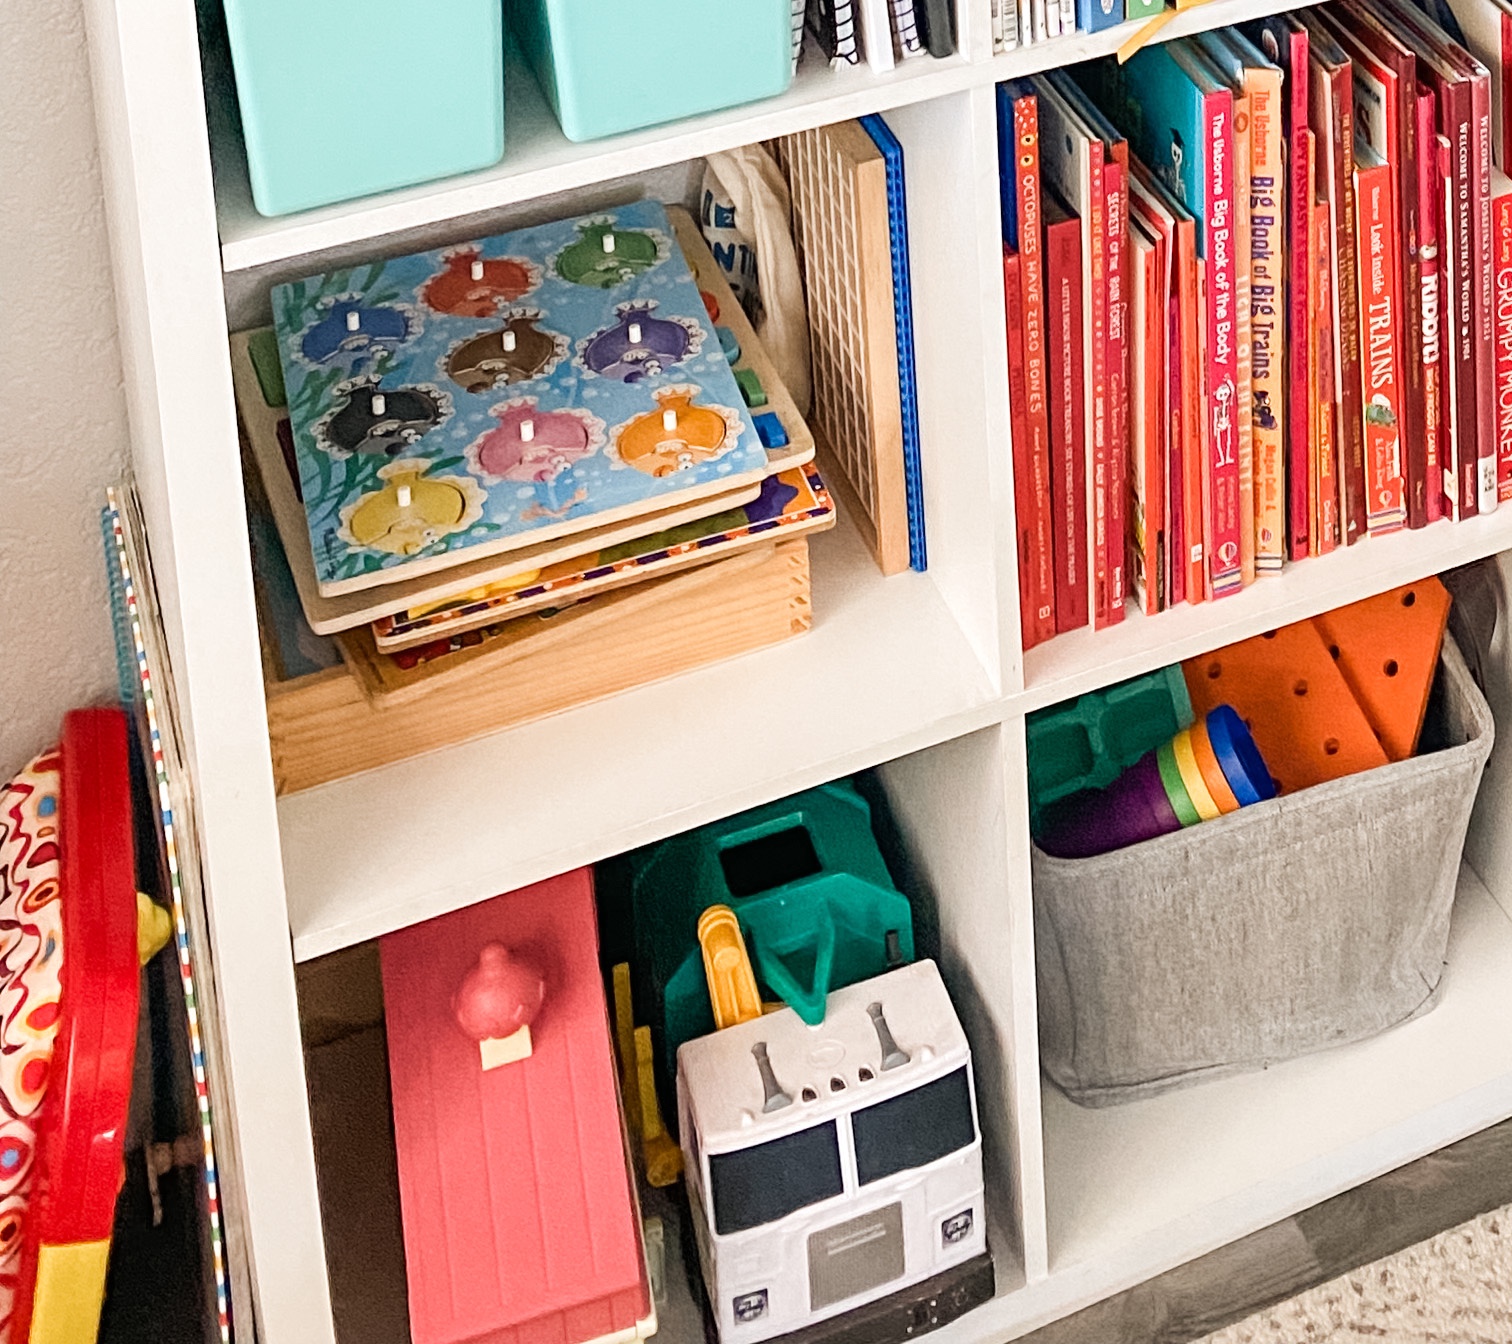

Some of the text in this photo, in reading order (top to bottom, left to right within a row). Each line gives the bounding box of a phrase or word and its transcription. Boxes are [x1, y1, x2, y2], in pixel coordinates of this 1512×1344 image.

[1210, 113, 1231, 364] The Usborne Big Book of the Body
[1368, 296, 1393, 388] TRAINS
